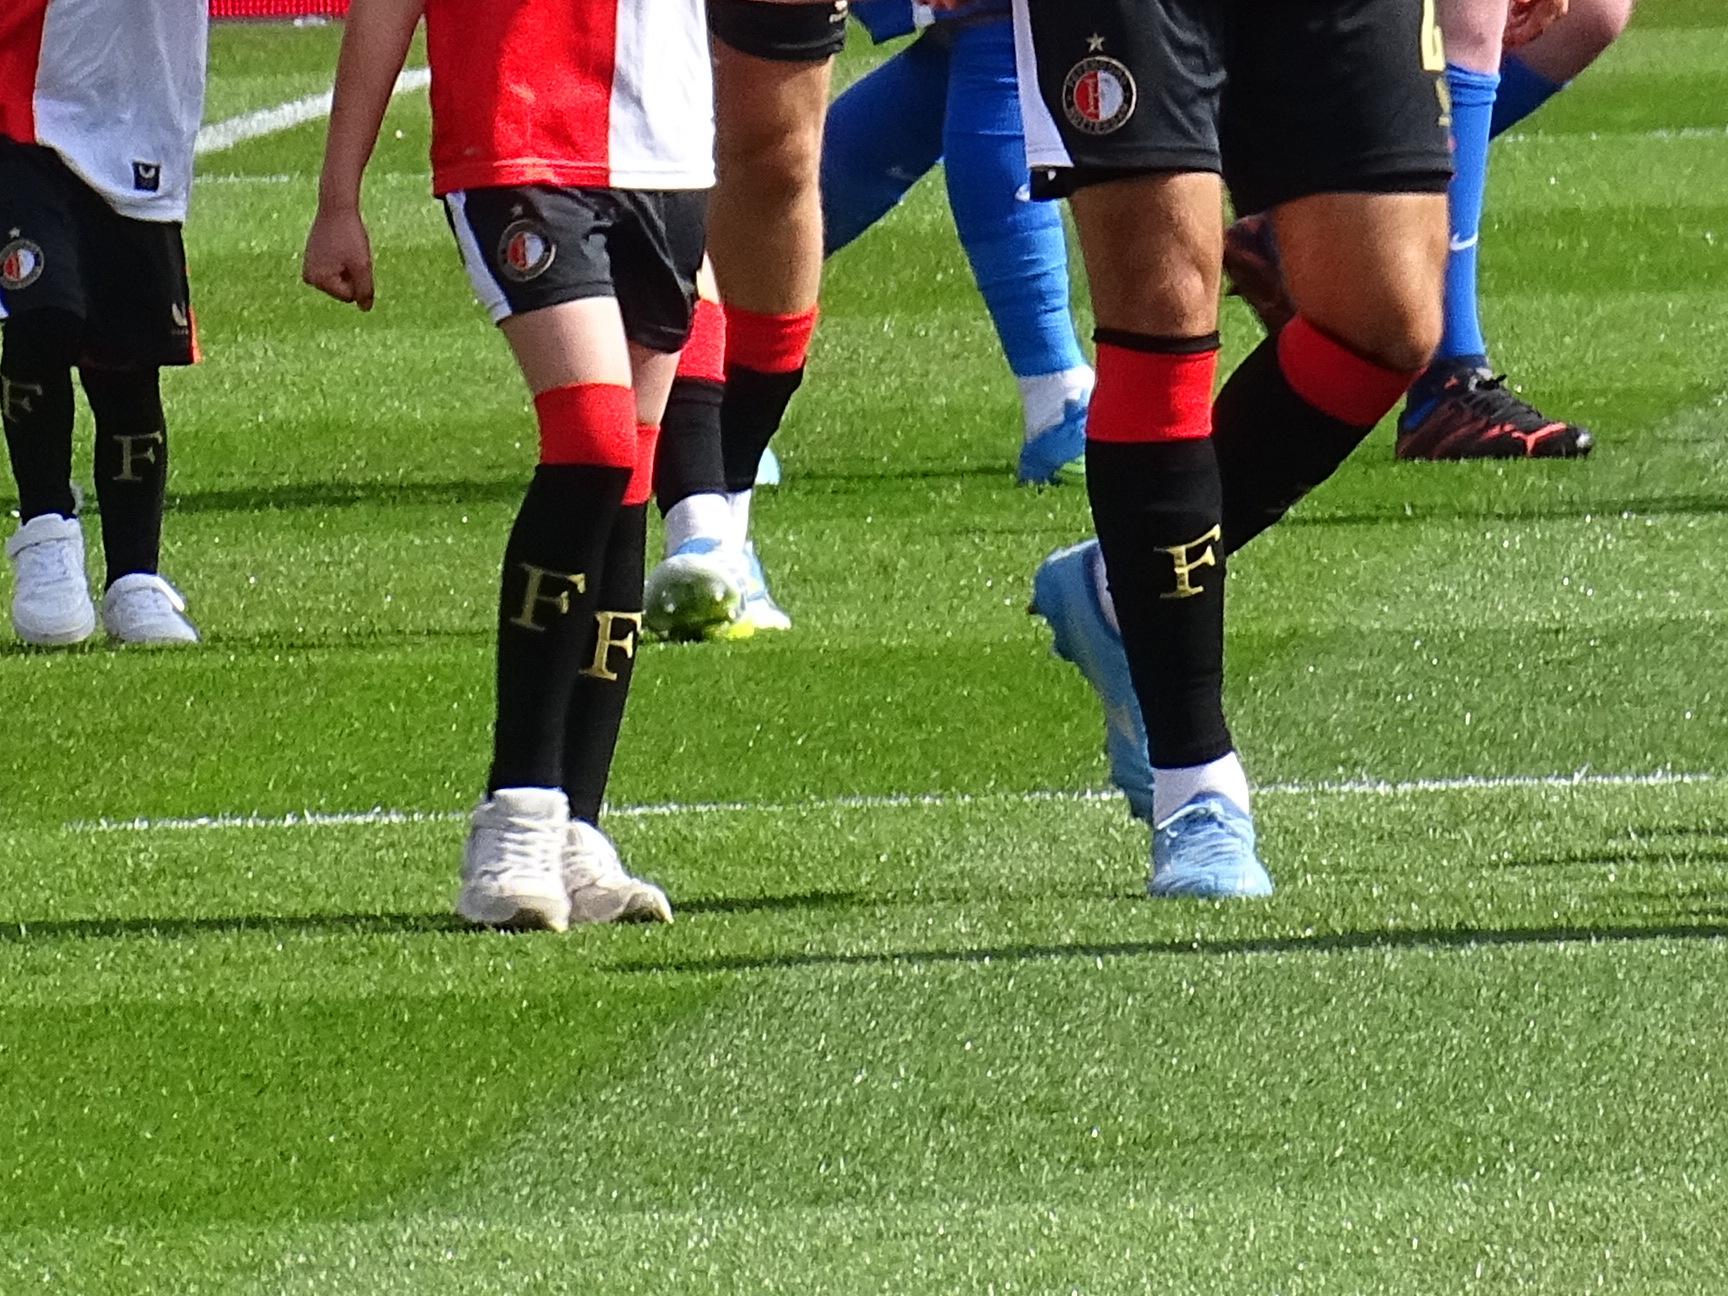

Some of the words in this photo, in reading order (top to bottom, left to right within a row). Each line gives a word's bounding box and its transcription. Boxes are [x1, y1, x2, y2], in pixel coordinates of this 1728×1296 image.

[0, 374, 43, 424] F
[112, 430, 164, 482] F
[1153, 523, 1222, 599] F
[510, 562, 587, 632] F
[578, 610, 646, 681] F
